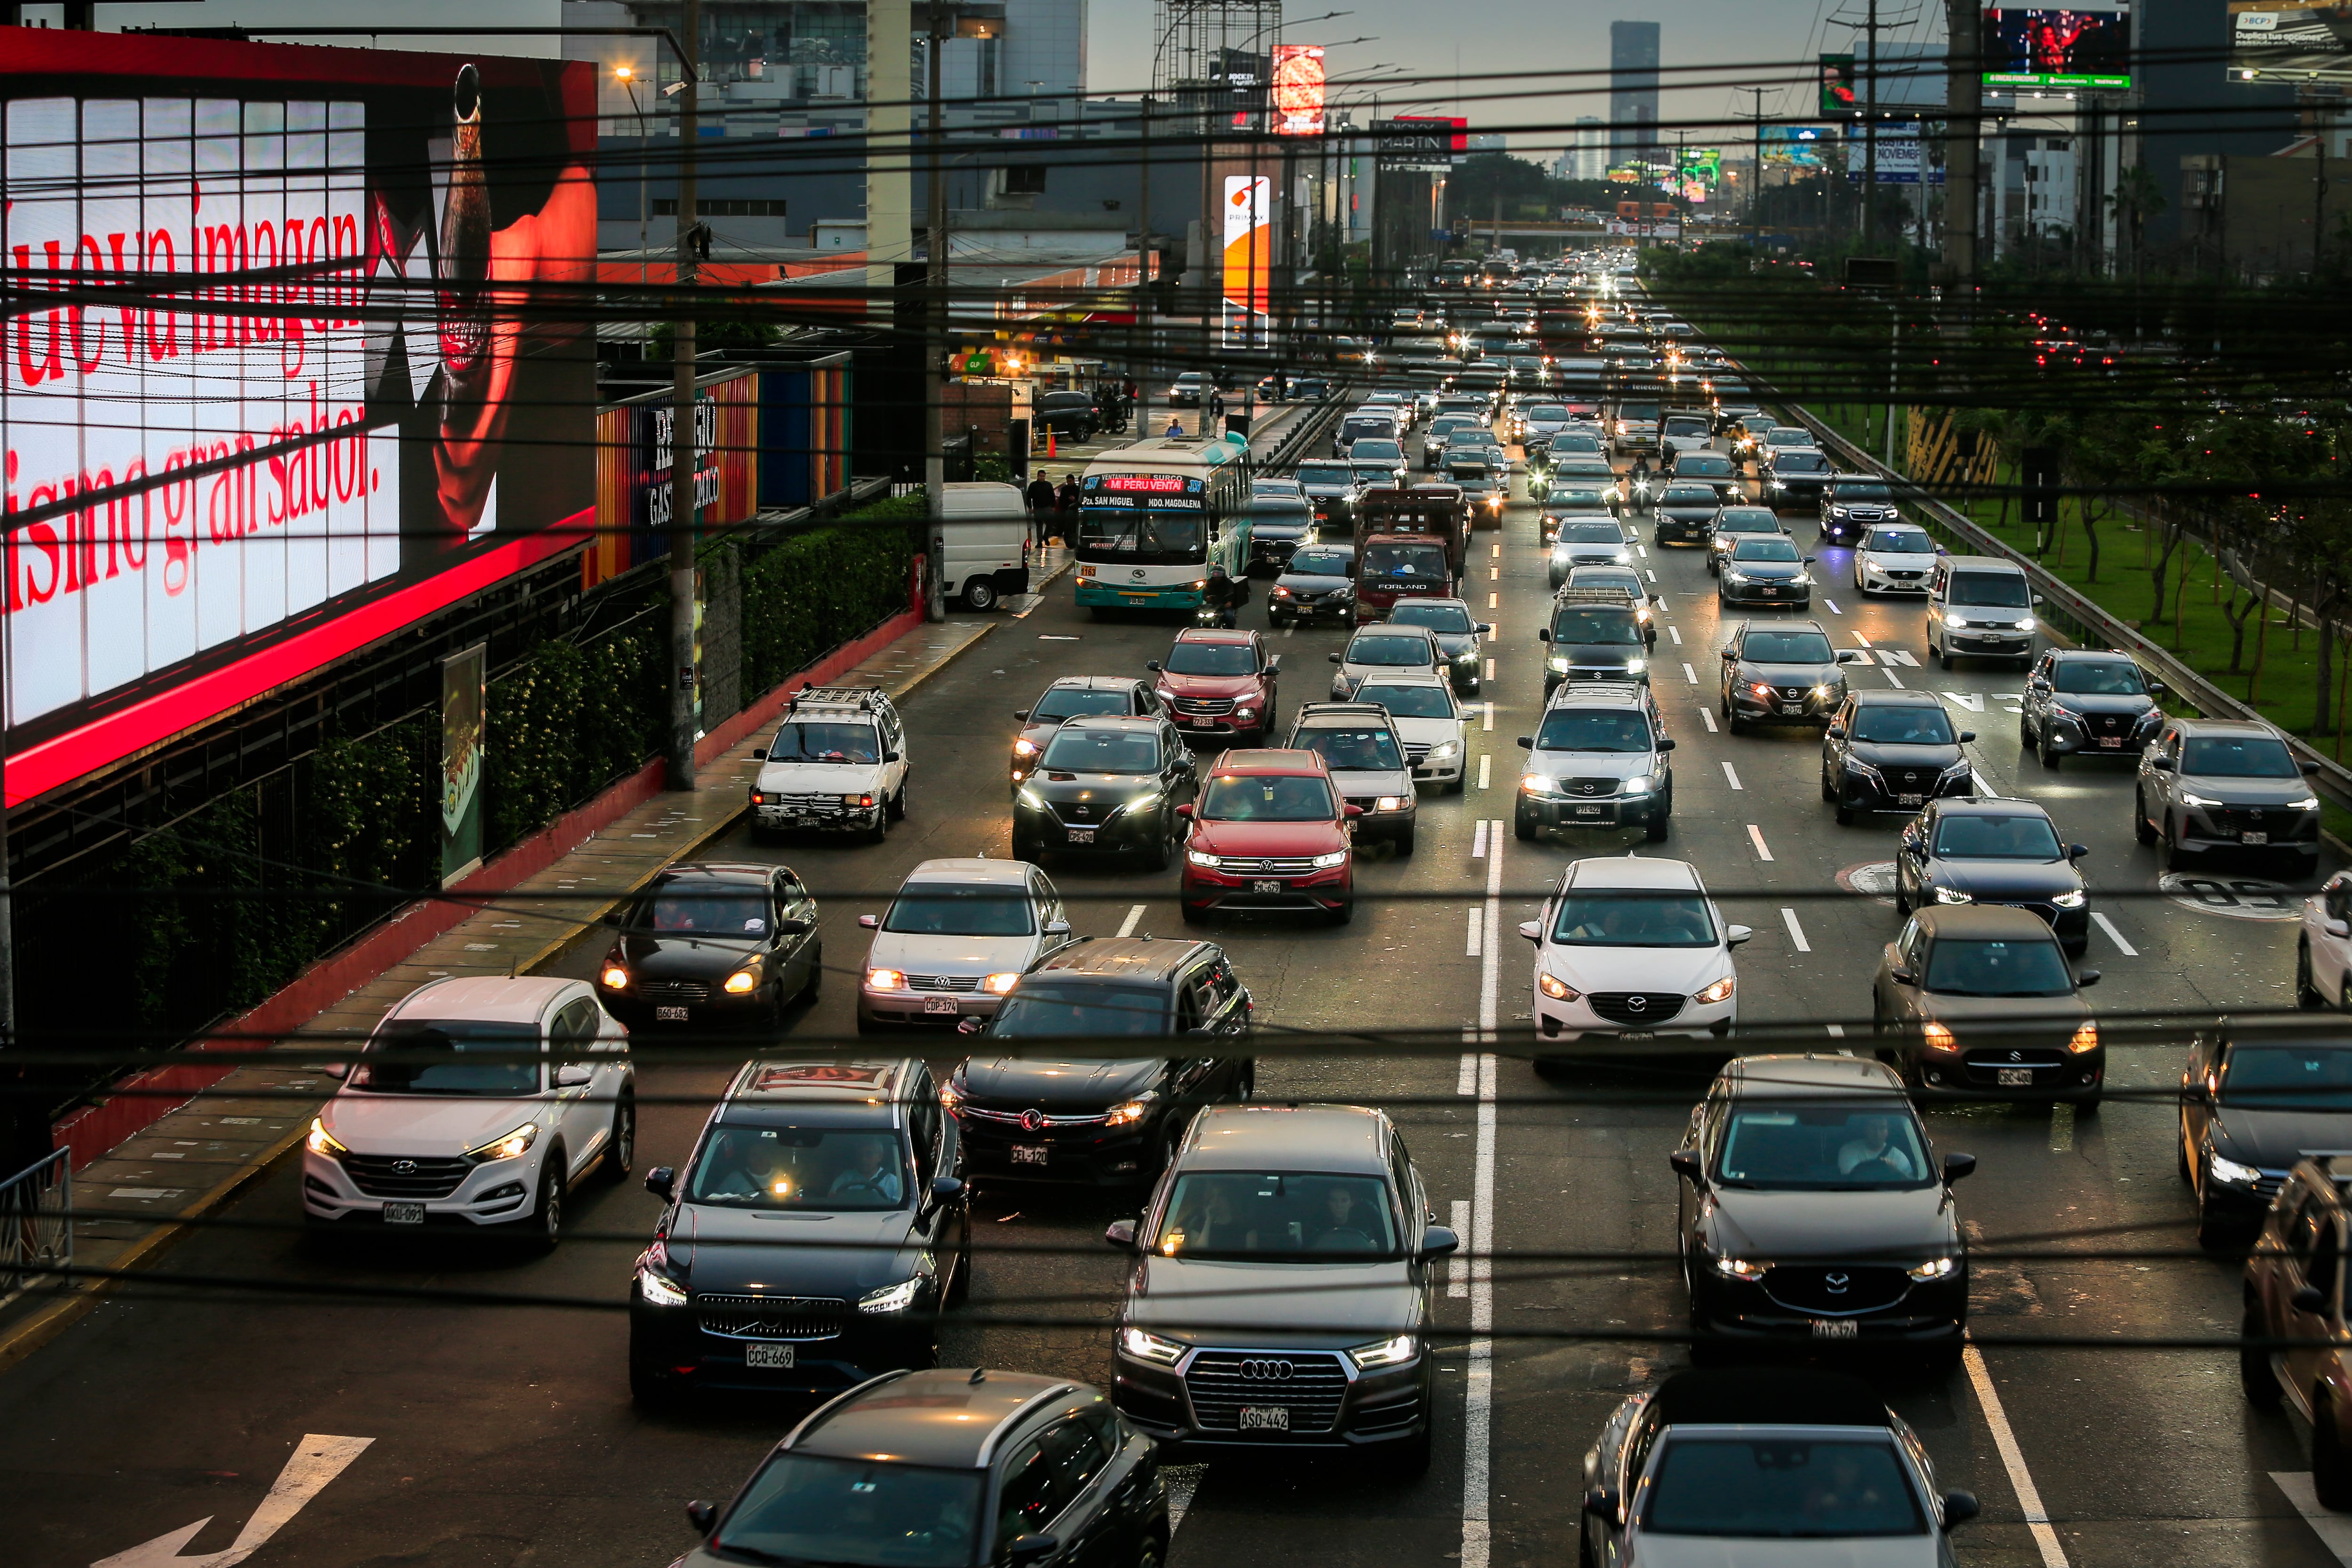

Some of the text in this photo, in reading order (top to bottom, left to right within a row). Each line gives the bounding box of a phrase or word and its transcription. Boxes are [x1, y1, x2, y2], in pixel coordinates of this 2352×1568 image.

[2236, 32, 2267, 40] Duplica
[1380, 136, 1440, 149] MARTIN
[162, 430, 257, 597] gran
[267, 379, 379, 526] sabor.
[1110, 480, 1121, 489] MI
[1124, 481, 1148, 490] PERU
[1095, 497, 1108, 505] SAN
[1109, 497, 1134, 507] MIGUEL
[1148, 499, 1201, 509] MDO. MAGDALENA
[1081, 566, 1096, 577] 1163
[1069, 832, 1093, 842] CPS-428
[1254, 883, 1279, 893] CML-679
[926, 1001, 956, 1012] CDP-174
[1012, 1150, 1047, 1164] CEL-120
[748, 1350, 792, 1365] CCQ-669
